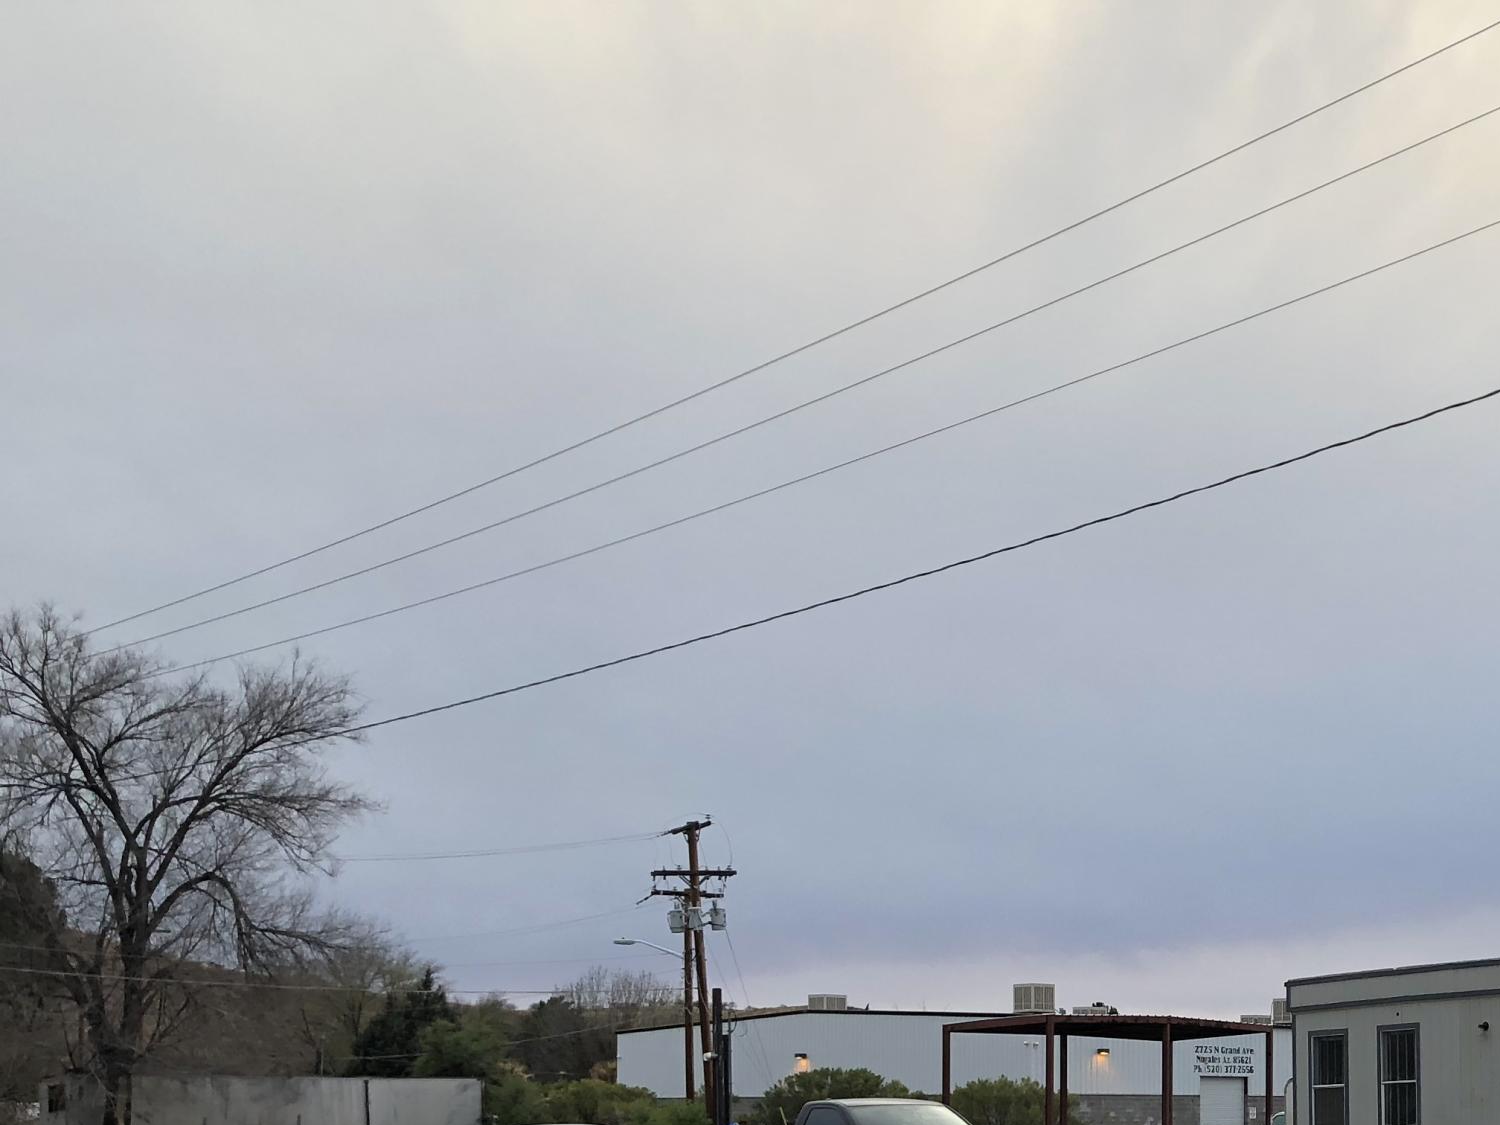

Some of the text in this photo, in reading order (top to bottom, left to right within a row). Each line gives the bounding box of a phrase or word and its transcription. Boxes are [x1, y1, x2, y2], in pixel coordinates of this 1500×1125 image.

[1194, 1045, 1213, 1054] 2725
[1214, 1046, 1220, 1054] N
[1220, 1046, 1241, 1055] Grand
